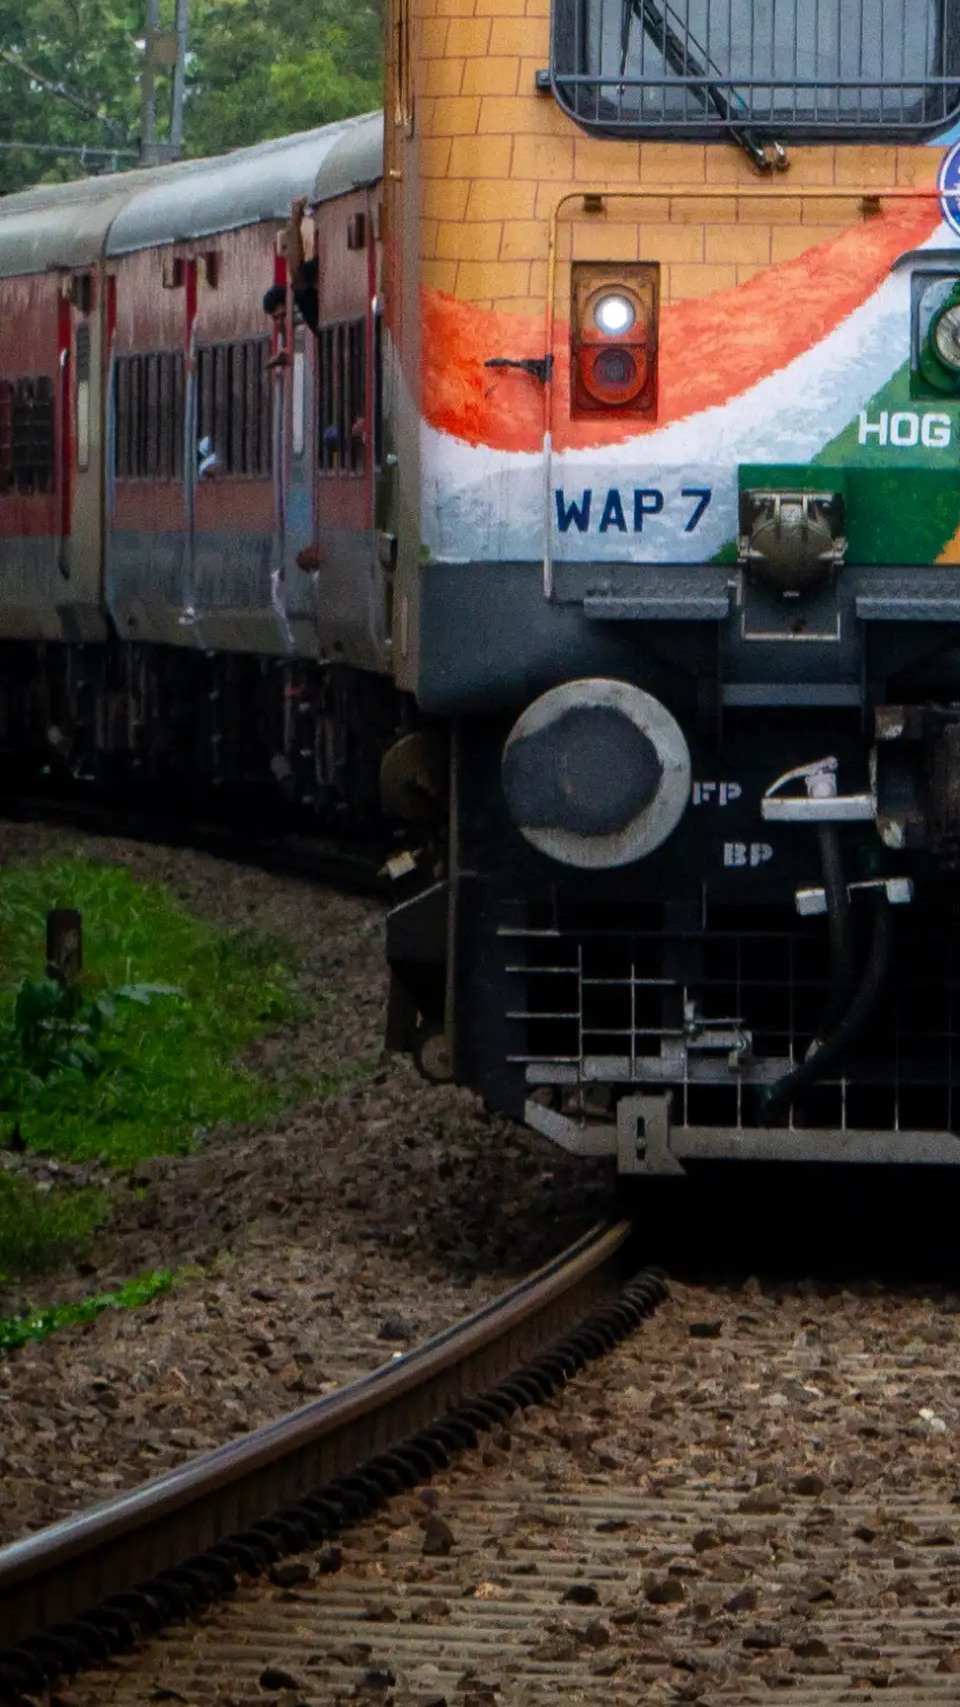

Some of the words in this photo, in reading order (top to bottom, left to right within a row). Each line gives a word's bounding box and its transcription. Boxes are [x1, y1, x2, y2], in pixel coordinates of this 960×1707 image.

[858, 410, 951, 448] HOG
[555, 488, 664, 533] WAP
[680, 488, 713, 533] 7
[692, 781, 743, 806] FP
[723, 841, 774, 867] BP
